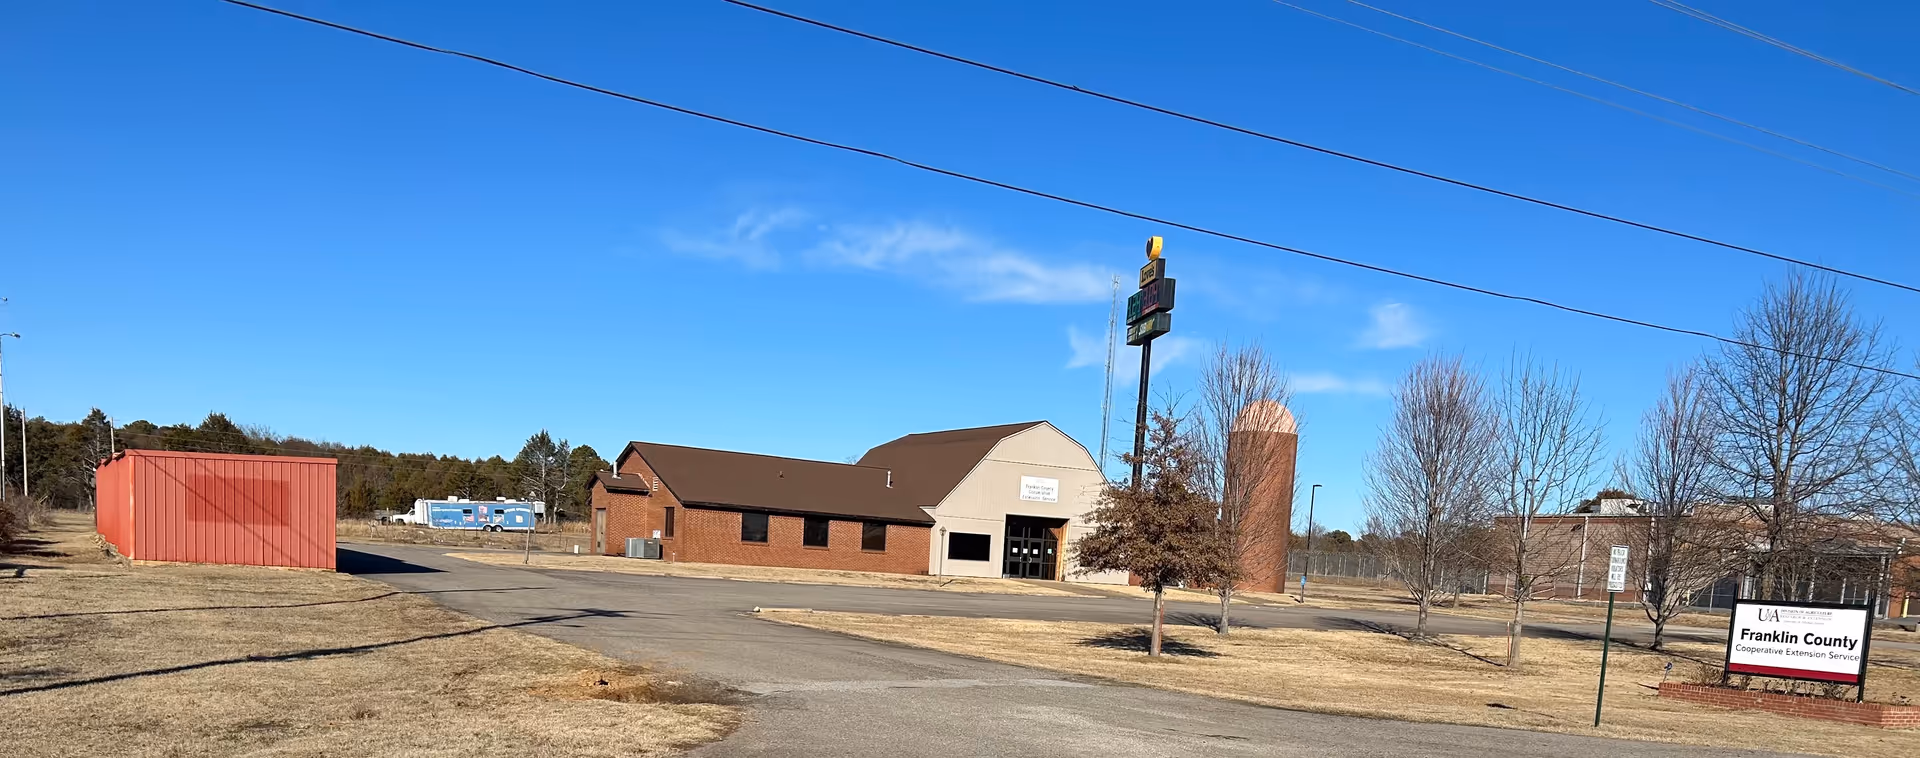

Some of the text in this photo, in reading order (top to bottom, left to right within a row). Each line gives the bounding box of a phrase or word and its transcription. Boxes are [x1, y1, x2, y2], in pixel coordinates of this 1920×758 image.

[1740, 628, 1858, 651] Franklin County
[1735, 644, 1860, 661] Cooperative Extension Service
